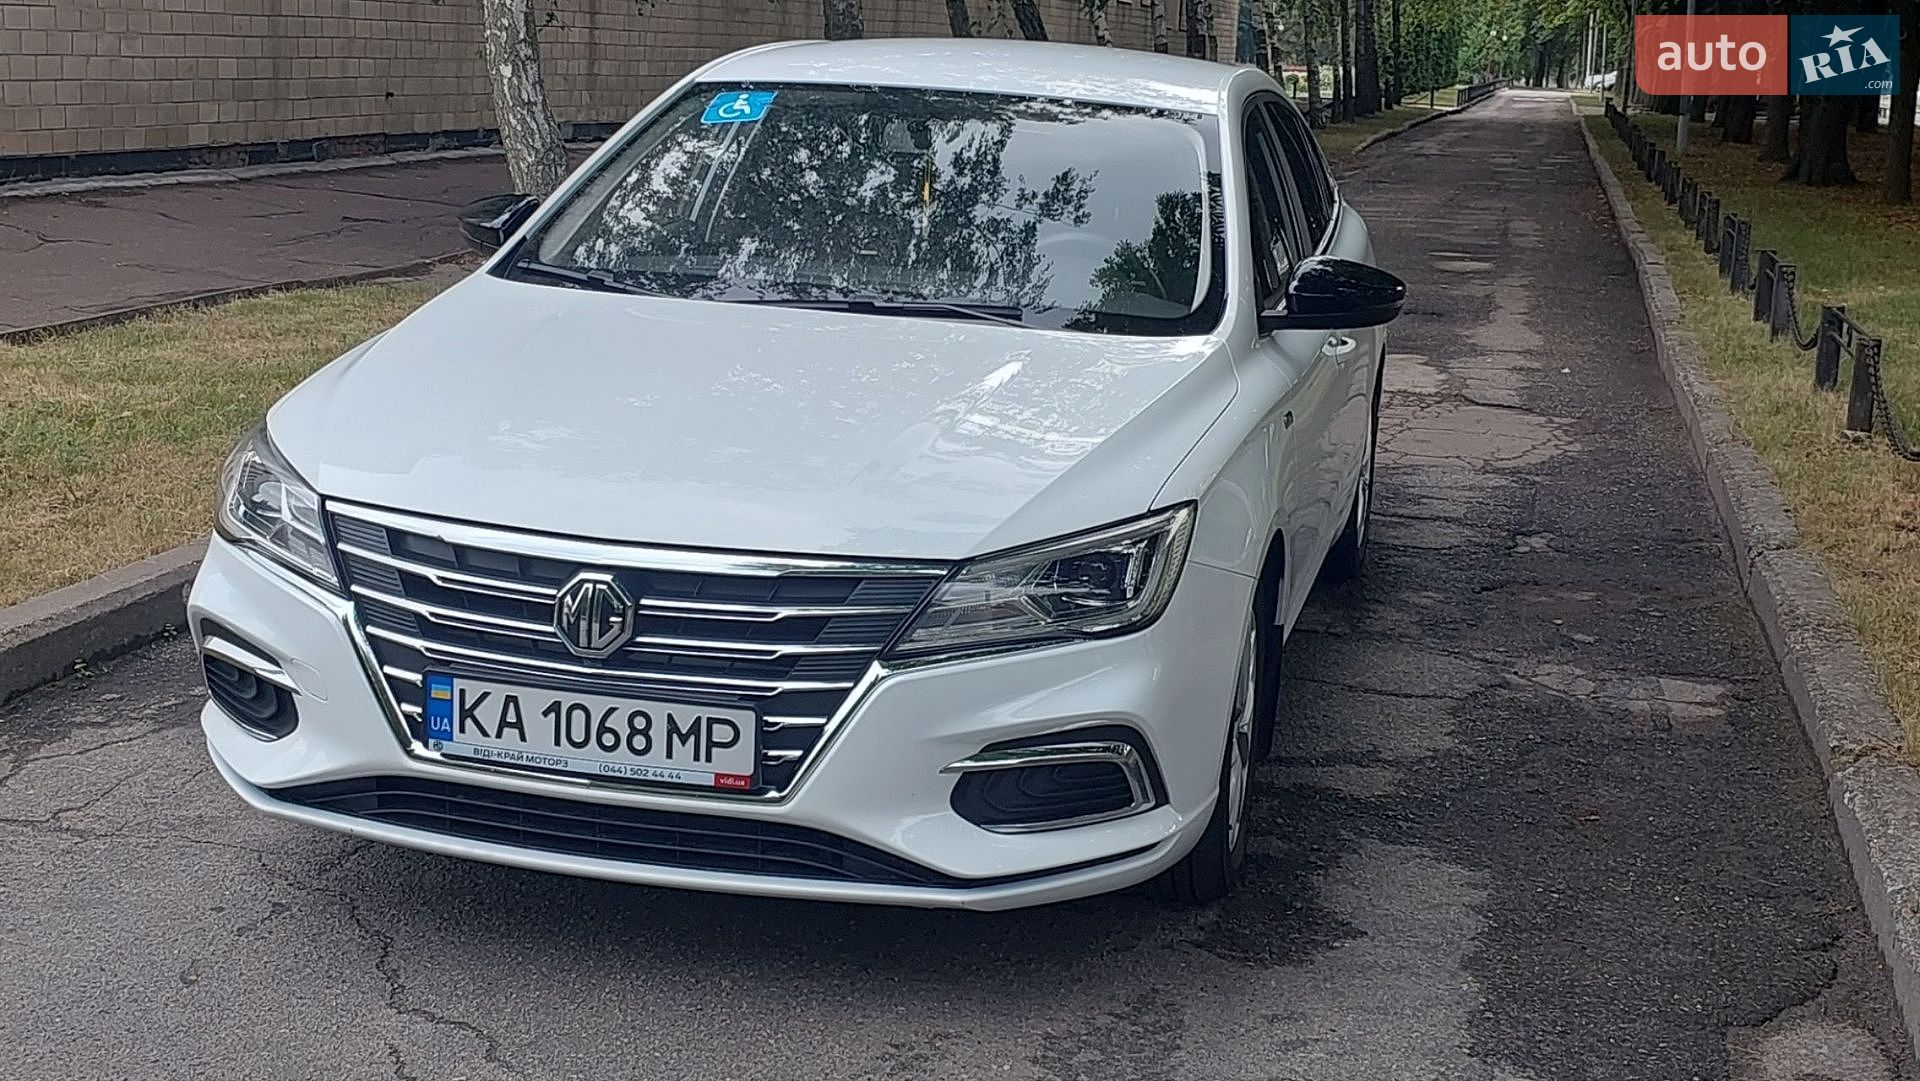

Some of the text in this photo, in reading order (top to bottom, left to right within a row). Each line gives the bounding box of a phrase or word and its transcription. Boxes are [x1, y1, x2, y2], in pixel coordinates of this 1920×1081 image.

[562, 583, 623, 649] MG
[430, 715, 451, 733] UA
[458, 687, 741, 764] KA 1068 MP
[598, 763, 682, 781] (044) 502 44 44
